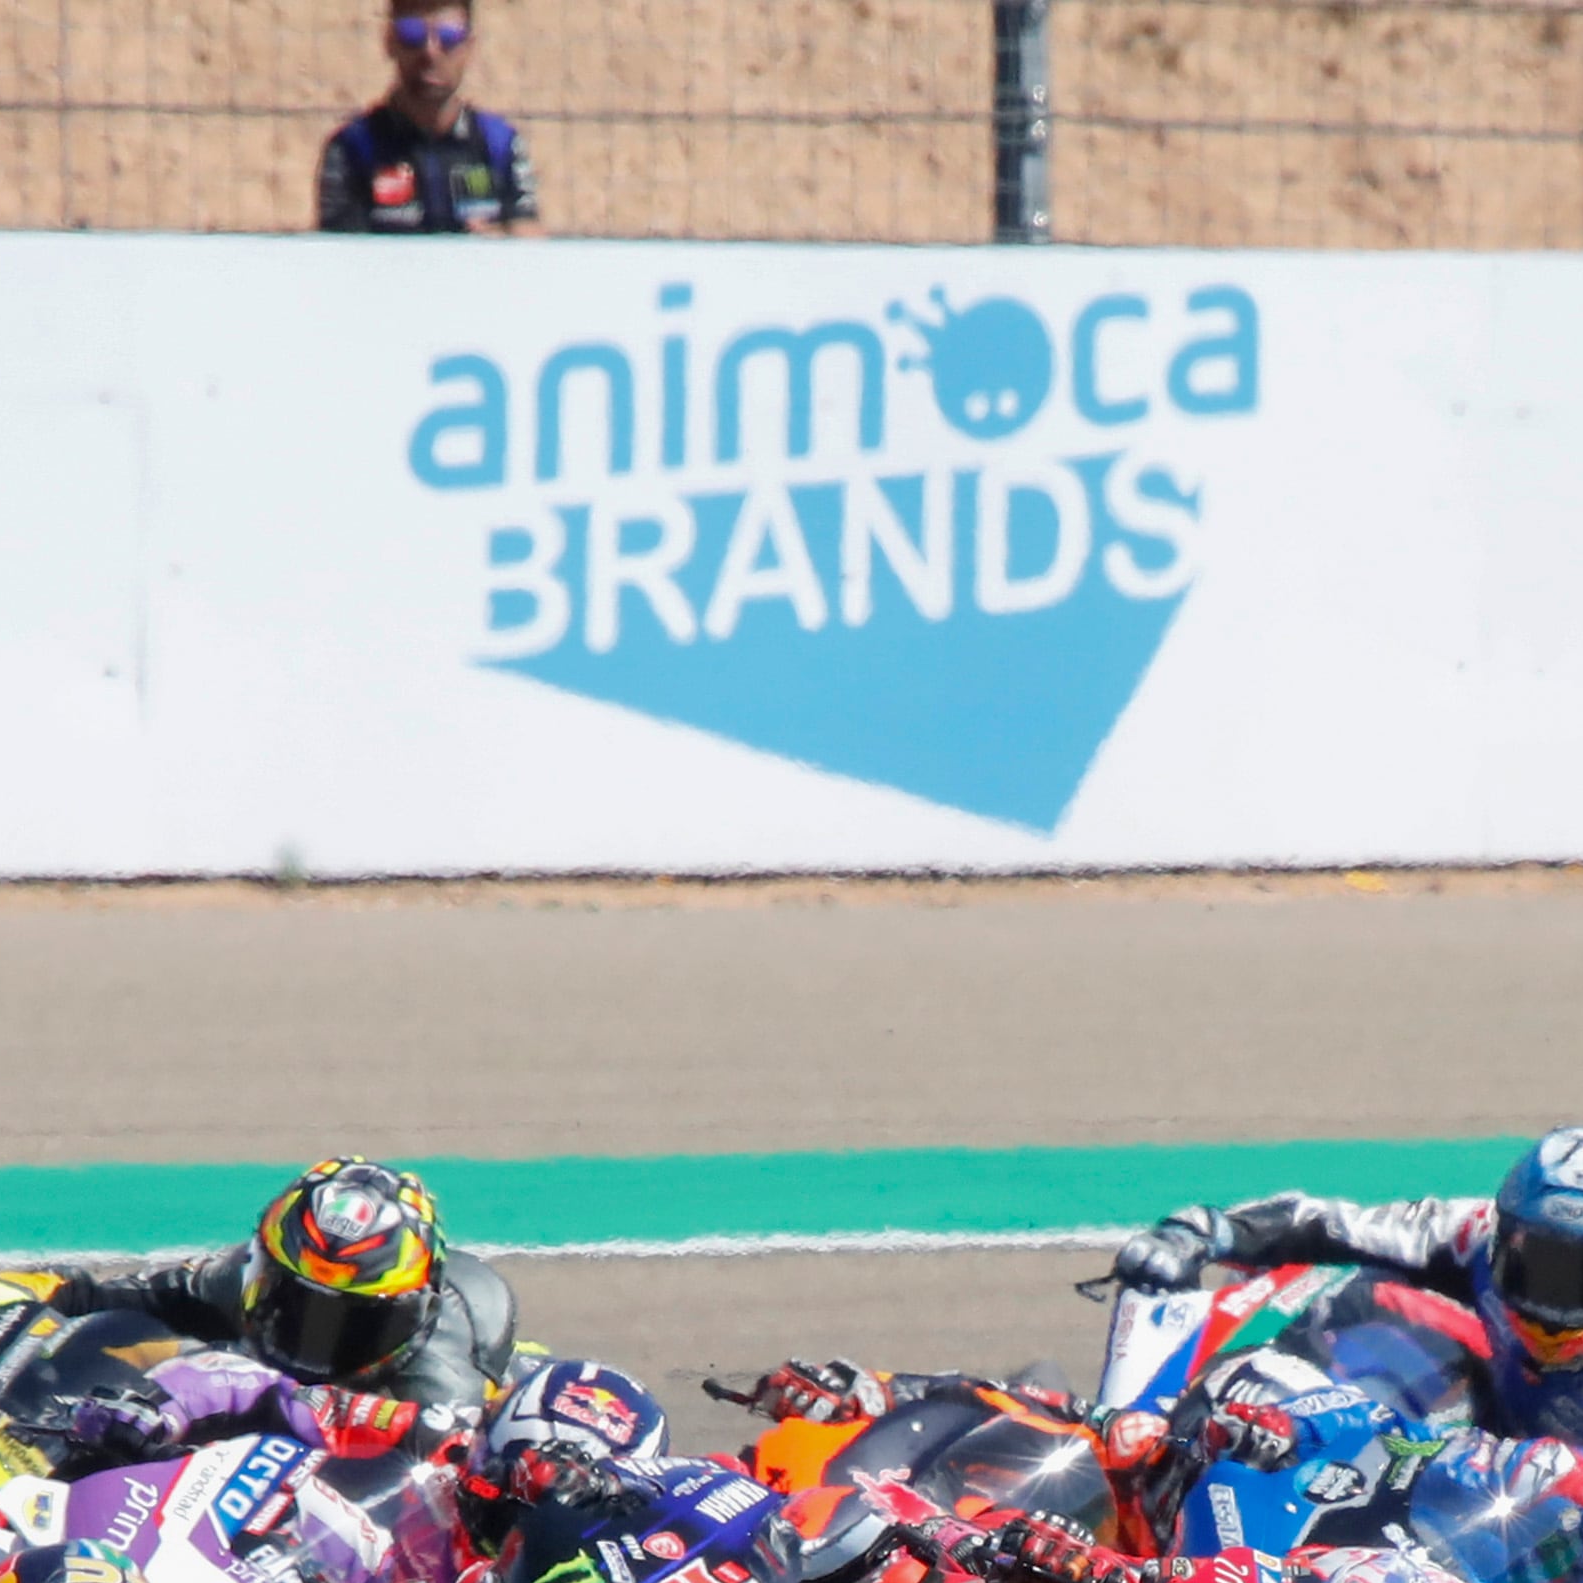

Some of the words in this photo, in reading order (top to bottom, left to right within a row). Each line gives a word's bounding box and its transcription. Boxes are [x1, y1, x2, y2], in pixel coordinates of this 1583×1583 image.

[407, 282, 1260, 490] animoca
[465, 455, 1203, 662] BRANDS
[101, 1476, 159, 1551] prim
[218, 1437, 298, 1521] OCTO
